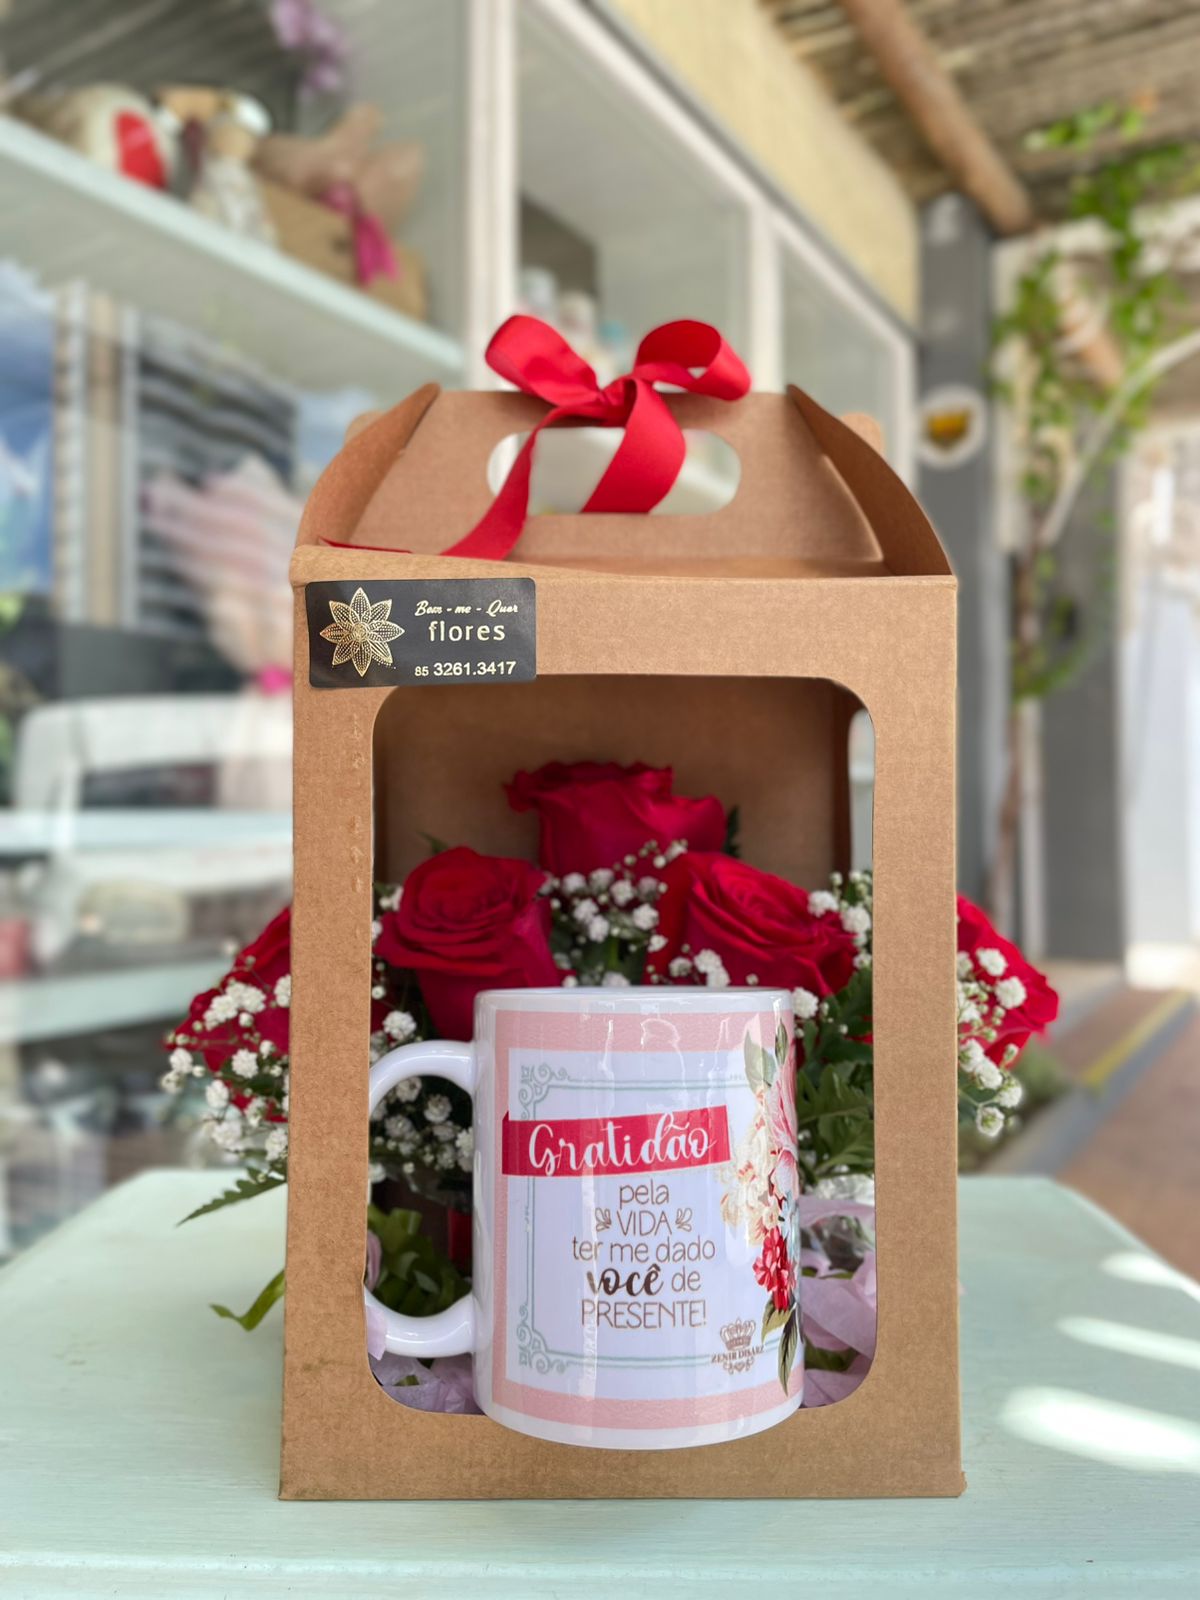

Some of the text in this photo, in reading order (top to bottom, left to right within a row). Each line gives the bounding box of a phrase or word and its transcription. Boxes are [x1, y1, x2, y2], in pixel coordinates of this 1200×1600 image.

[486, 599, 518, 617] Quer
[428, 620, 506, 642] flores
[414, 661, 517, 677] 85 3261.3417
[528, 1112, 717, 1177] Gratidão
[619, 1179, 670, 1209] pela
[616, 1210, 673, 1236] VIDA
[572, 1235, 716, 1263] ter me dado
[586, 1263, 702, 1297] você de
[581, 1299, 706, 1329] PRESENTE!
